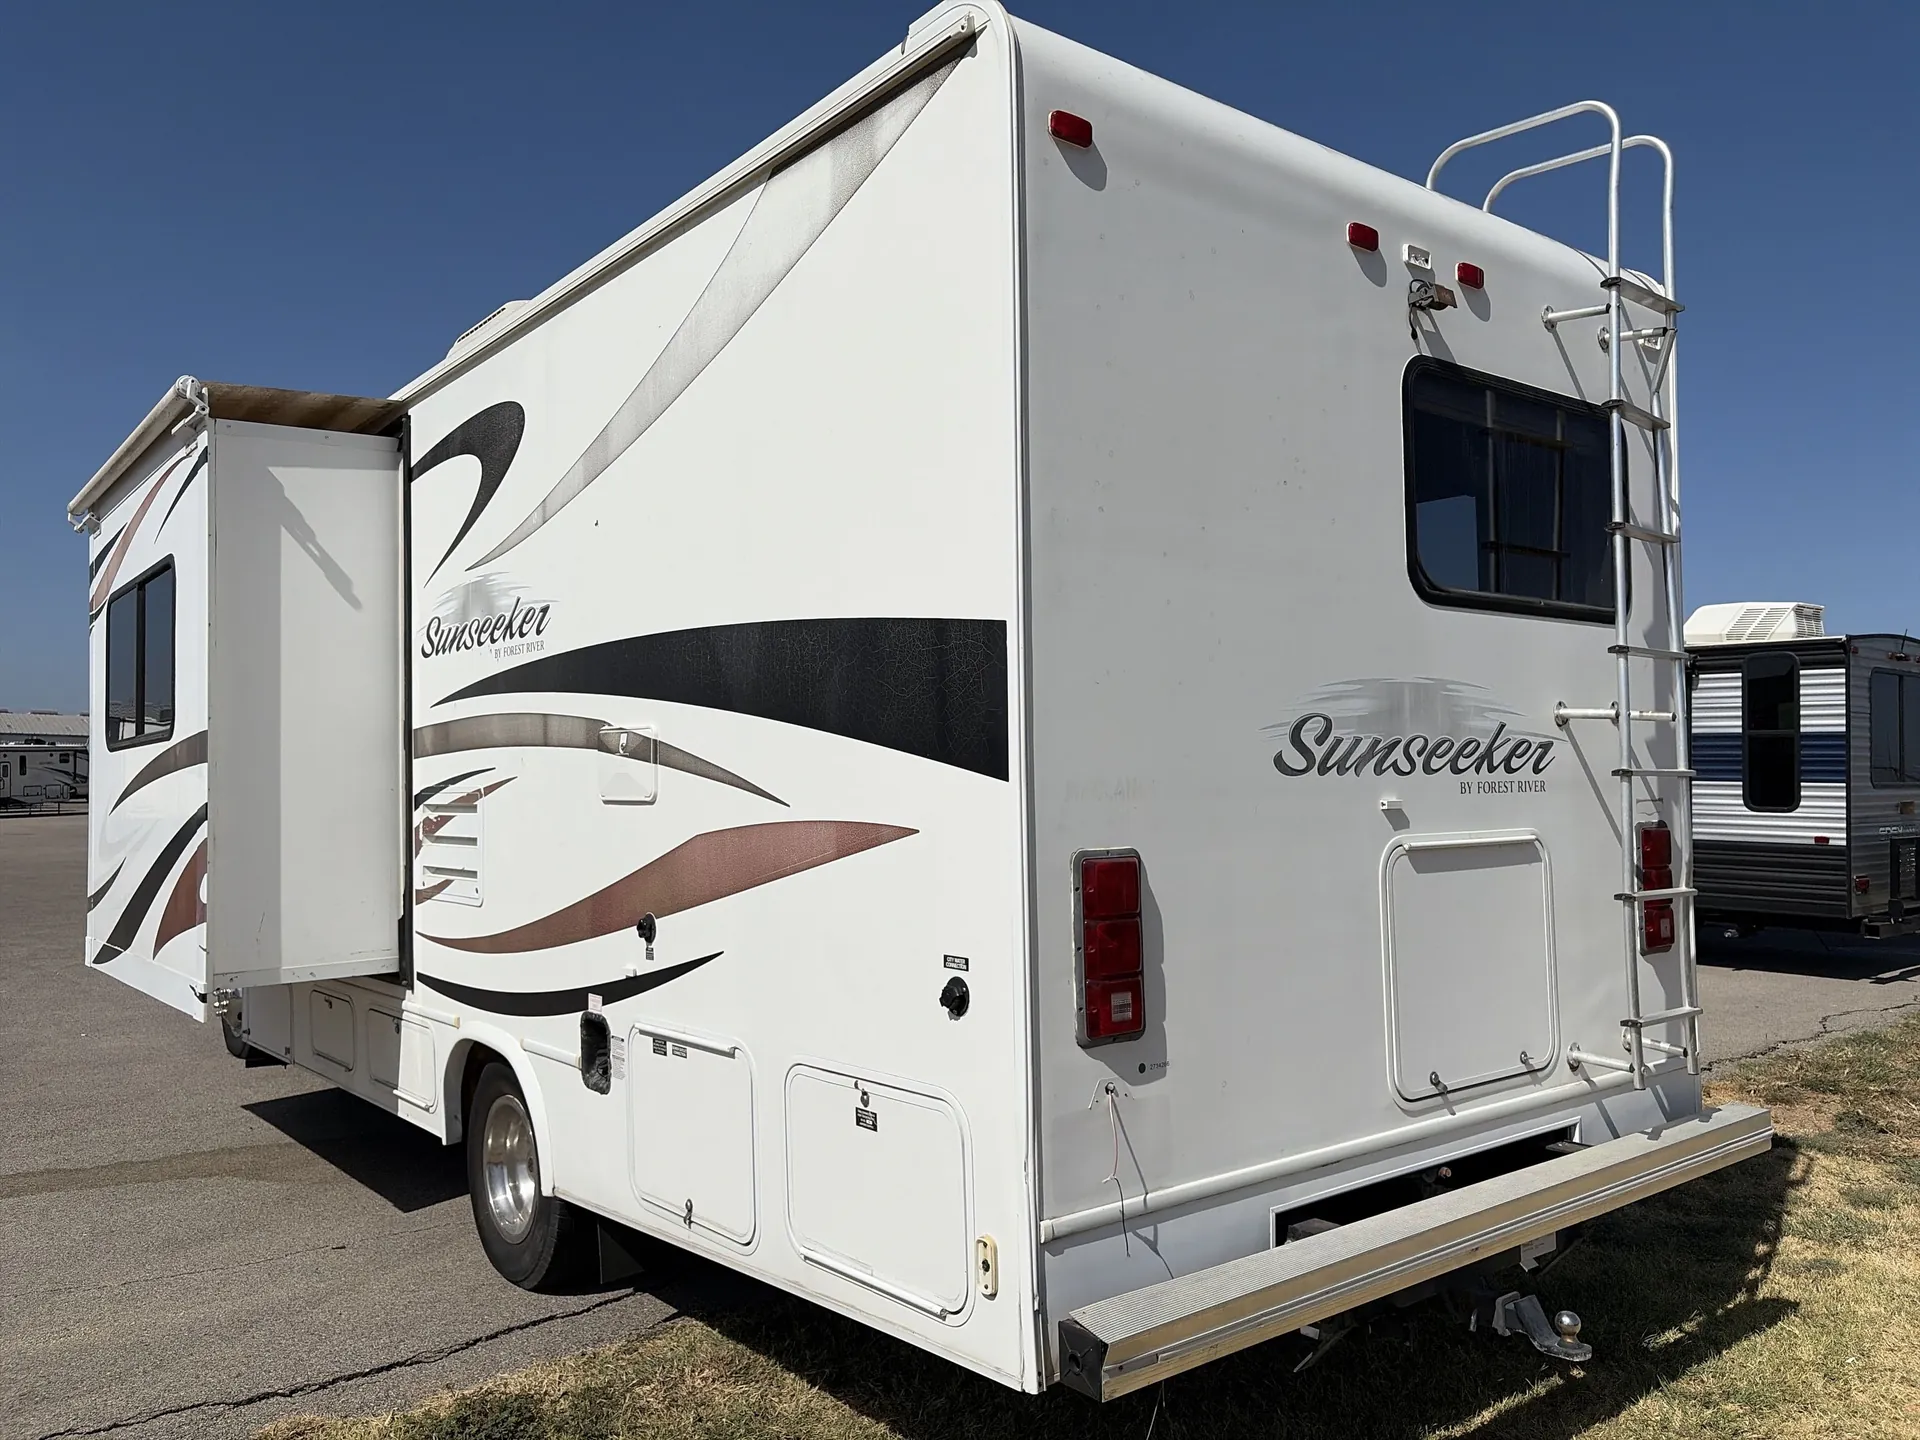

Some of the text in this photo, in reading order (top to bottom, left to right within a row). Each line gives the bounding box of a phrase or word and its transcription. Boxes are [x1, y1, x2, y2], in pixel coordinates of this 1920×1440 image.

[421, 596, 551, 658] Sunseeker
[494, 640, 545, 659] BY FOREST RIVER
[1273, 712, 1555, 777] Sunseeker
[1460, 780, 1546, 794] BY FOREST RIVER
